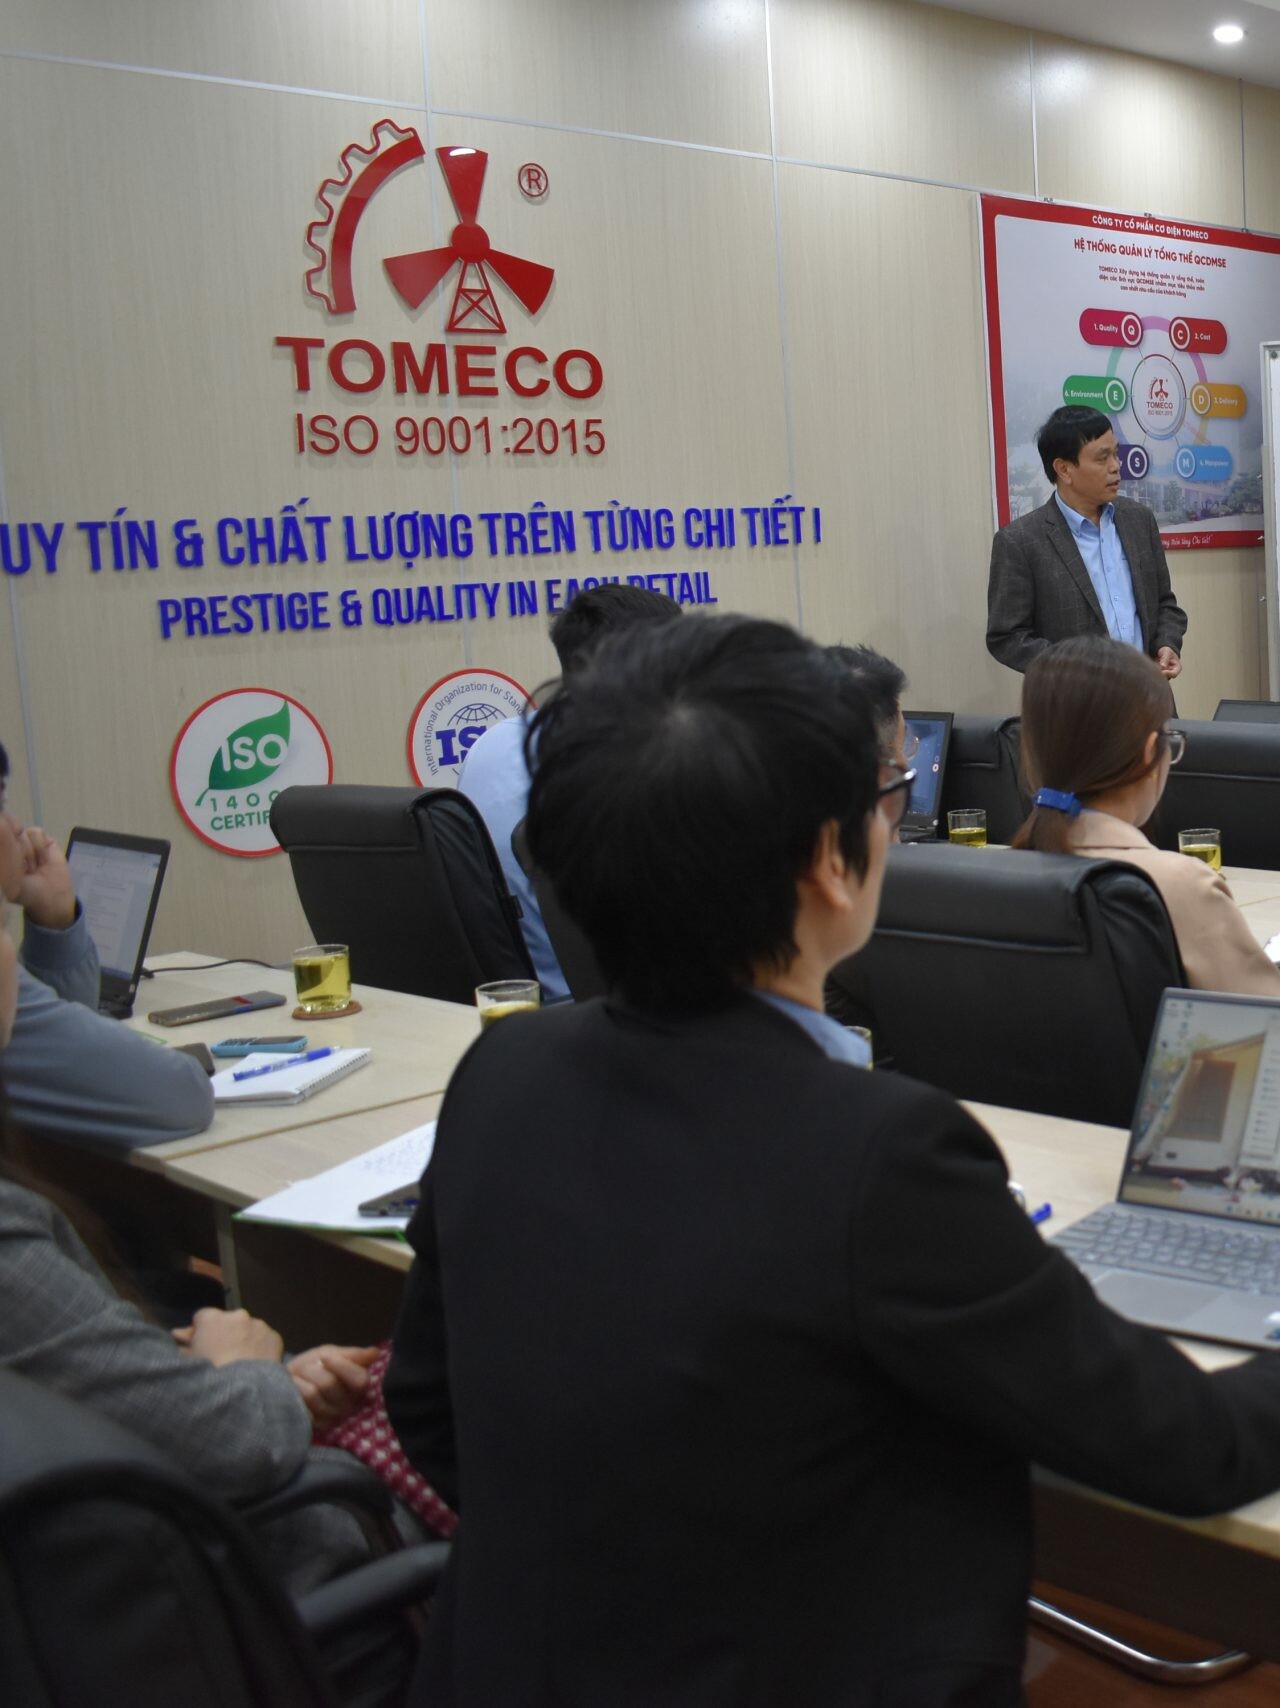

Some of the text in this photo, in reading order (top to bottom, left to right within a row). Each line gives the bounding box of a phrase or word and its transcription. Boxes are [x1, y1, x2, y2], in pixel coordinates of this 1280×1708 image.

[1114, 218, 1123, 228] TY
[1182, 228, 1209, 240] TOMECO
[1074, 237, 1085, 253] HỆ
[1086, 237, 1117, 254] THỐNG
[1118, 241, 1143, 257] QUẢN
[1193, 255, 1227, 268] QCDMSE
[1099, 323, 1118, 333] Quality
[275, 335, 604, 400] TOMECO
[1146, 401, 1174, 409] TOMECO
[296, 413, 606, 456] ISO 9001:2015
[0, 521, 64, 576] UY
[76, 507, 159, 573] TÍN
[173, 518, 205, 568] &
[217, 497, 332, 567] CHẤT
[343, 510, 474, 570] LƯỢNG
[479, 500, 577, 557] TRÊN
[583, 499, 676, 553] TỪNG
[684, 505, 736, 549] CHI
[741, 493, 806, 547] TIẾT
[157, 591, 331, 640] PRESTIGE
[340, 589, 363, 628] &
[371, 582, 501, 627] QUALITY
[507, 580, 538, 617] IN
[423, 711, 439, 776] International
[434, 681, 488, 712] Organization
[490, 683, 503, 695] for
[435, 725, 488, 767] IS
[220, 733, 288, 772] ISO
[210, 810, 271, 831] CERTIF
